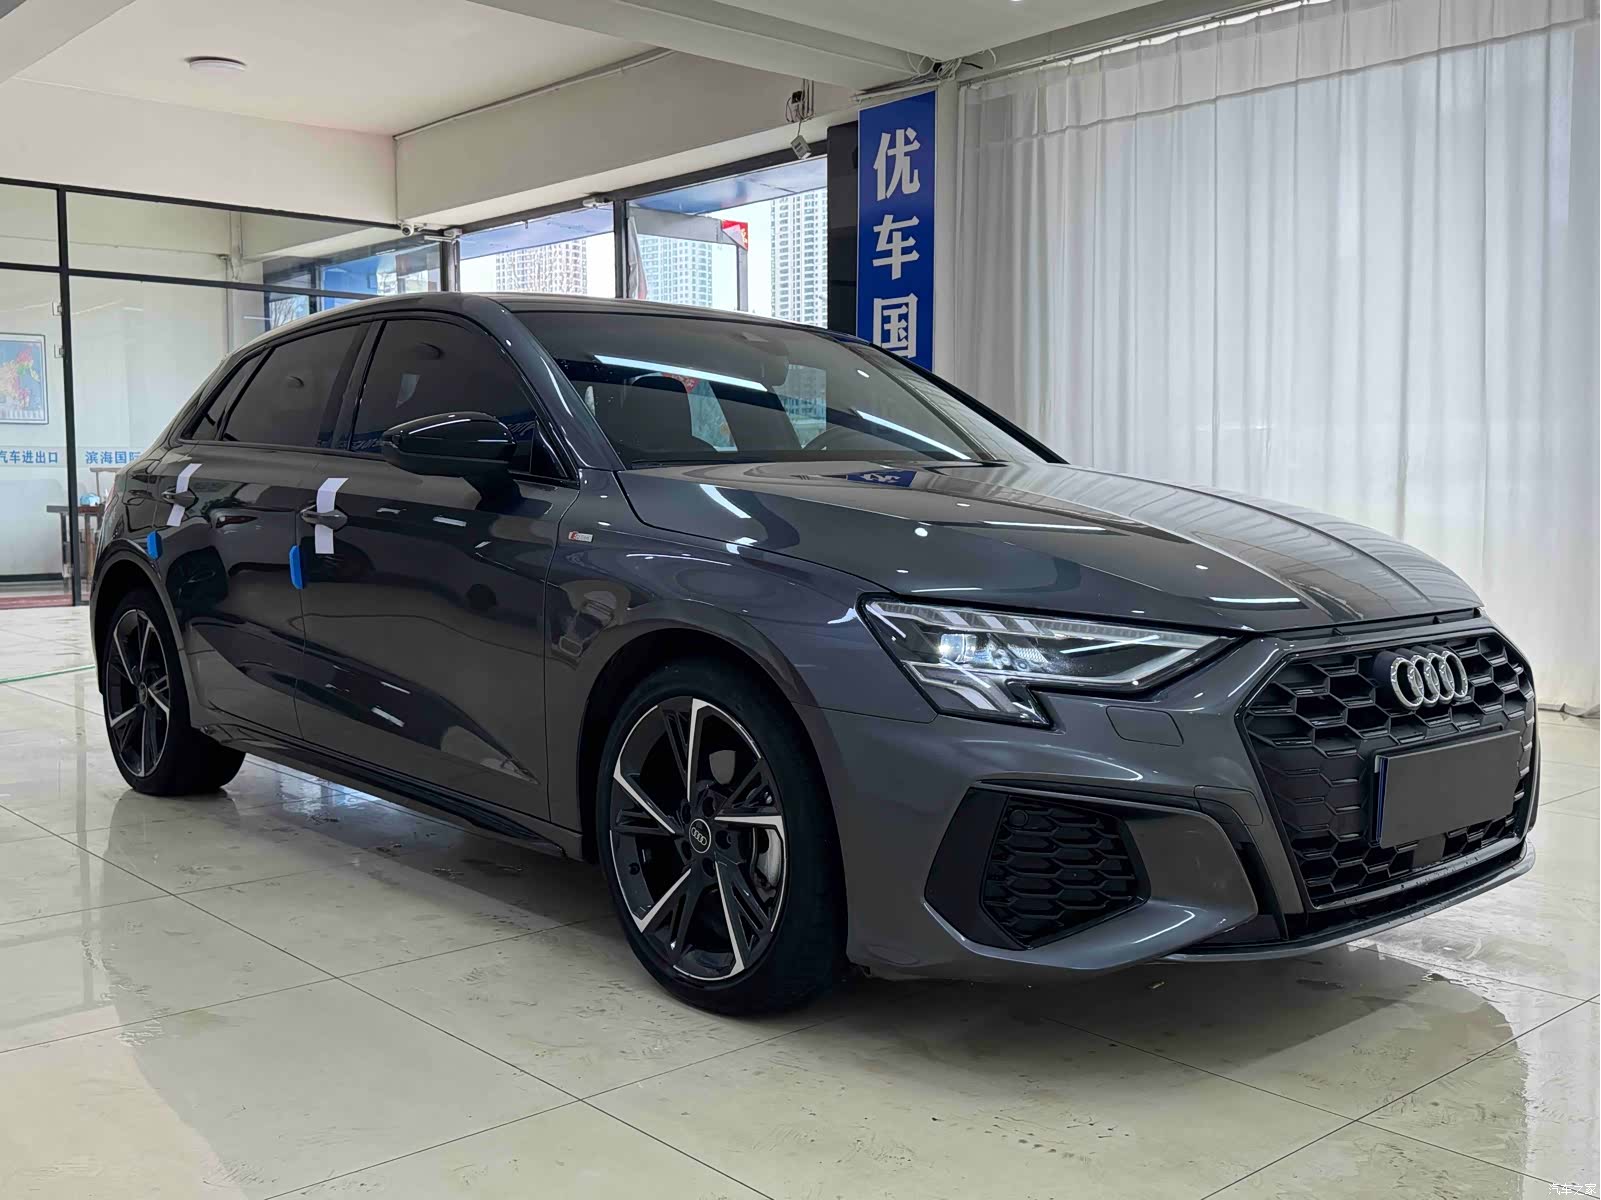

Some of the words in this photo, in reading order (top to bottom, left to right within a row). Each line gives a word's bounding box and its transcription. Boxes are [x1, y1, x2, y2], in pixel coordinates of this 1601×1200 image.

[872, 127, 921, 359] 优车国
[0, 450, 58, 464] 汽车进出口
